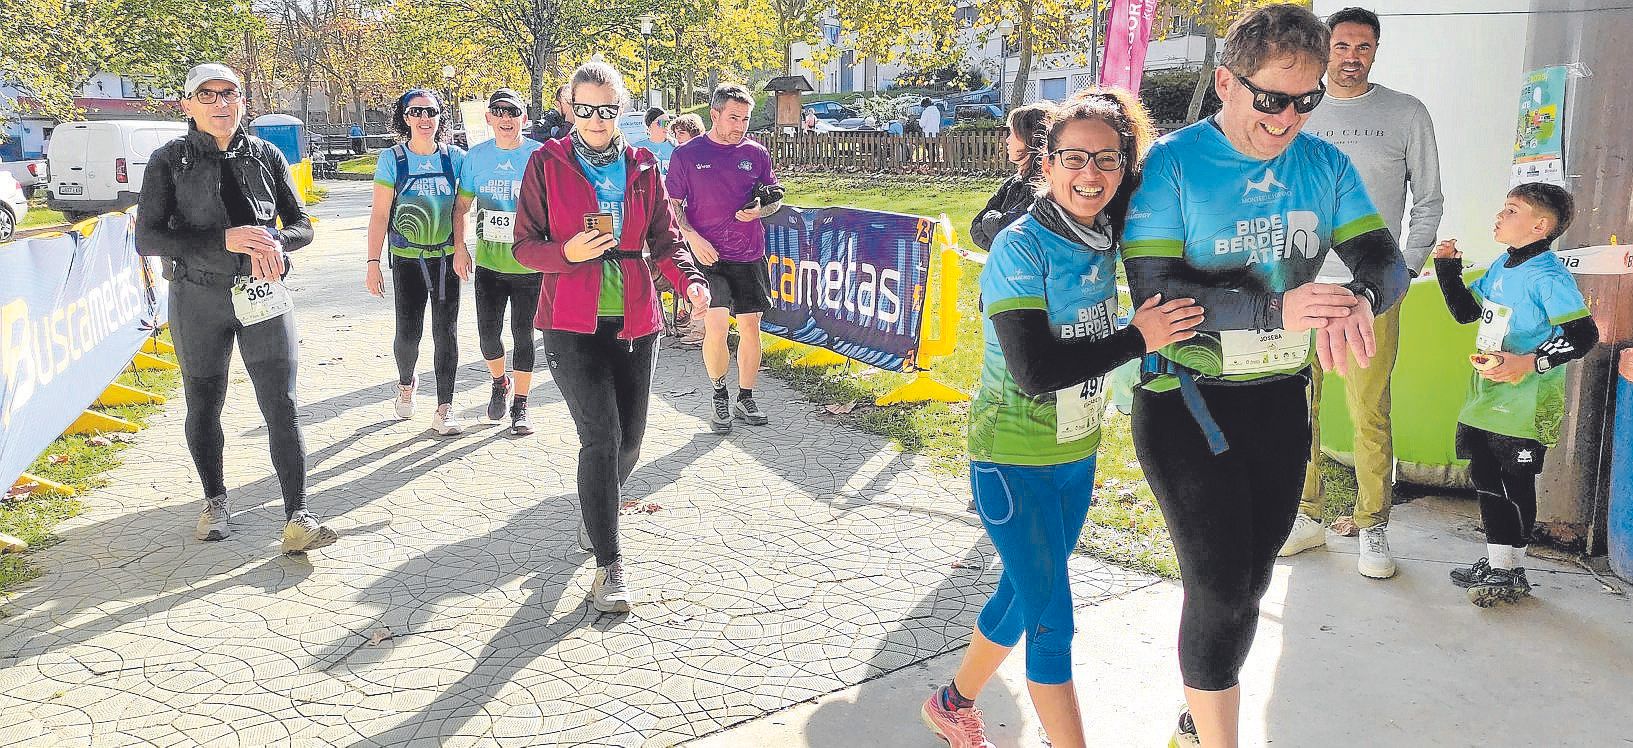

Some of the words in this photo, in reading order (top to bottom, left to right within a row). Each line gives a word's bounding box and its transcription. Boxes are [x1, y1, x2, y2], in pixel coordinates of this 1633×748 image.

[1342, 129, 1384, 137] CLUB
[480, 186, 510, 194] BERDE
[490, 216, 510, 226] 463
[1236, 214, 1283, 236] BIDE
[1214, 229, 1284, 255] BERDE
[1246, 245, 1283, 267] ATE
[247, 282, 273, 301] 362
[1078, 302, 1106, 322] BIDE
[1060, 317, 1112, 339] BERDE
[1259, 333, 1283, 343] JOSEBA
